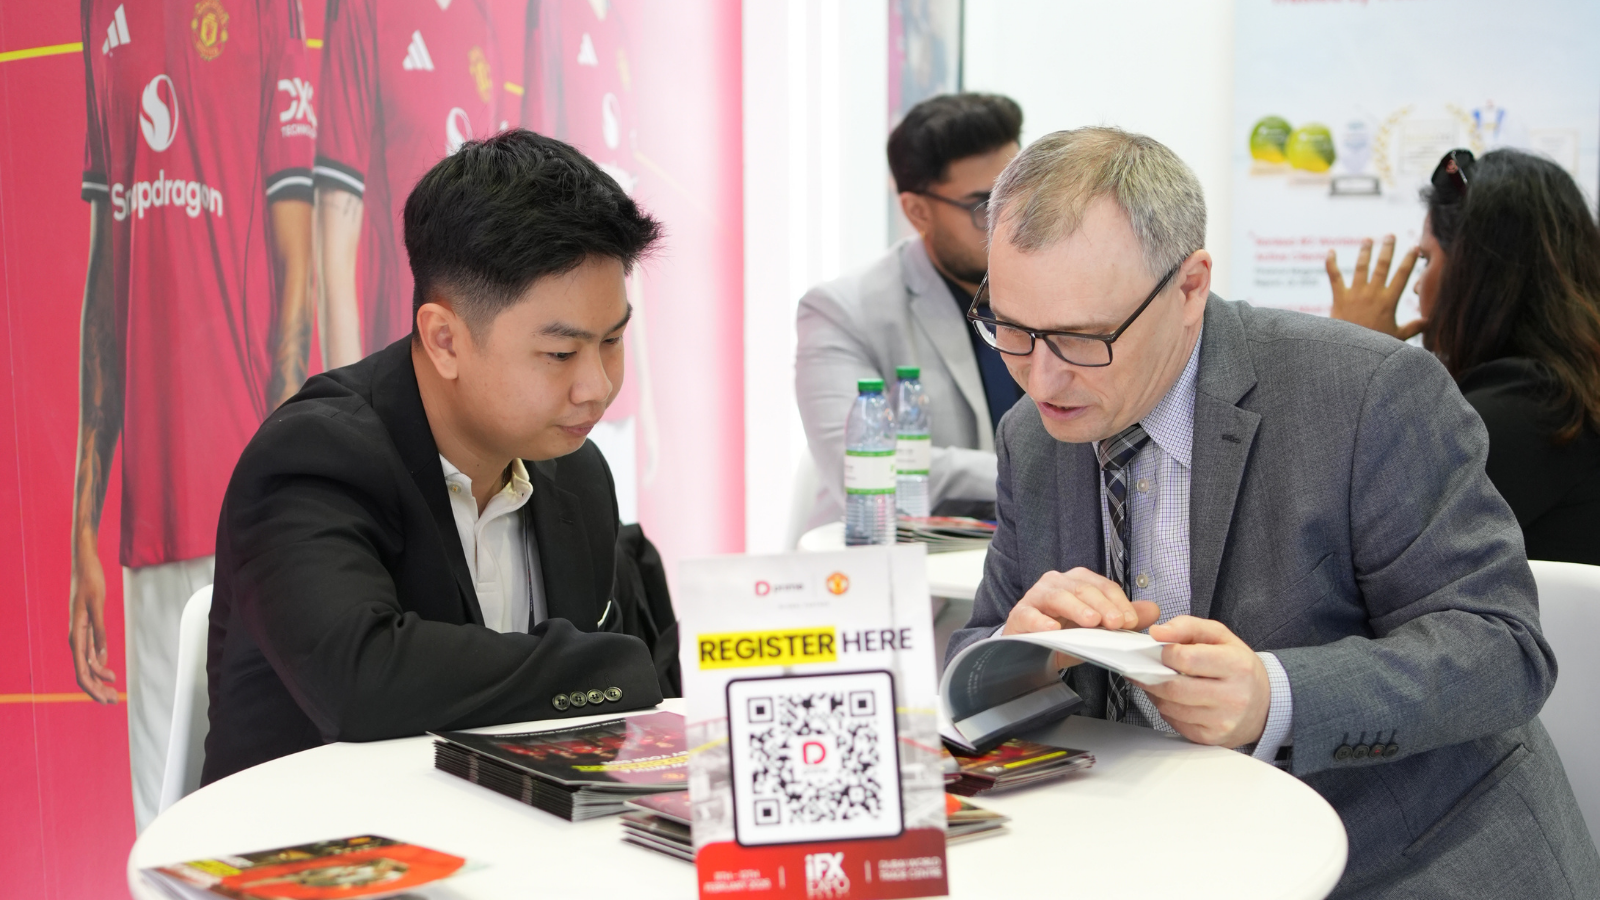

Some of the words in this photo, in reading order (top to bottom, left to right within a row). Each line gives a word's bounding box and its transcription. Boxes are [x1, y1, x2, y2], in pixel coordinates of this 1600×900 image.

[111, 169, 223, 221] Snapdragon
[700, 633, 834, 662] REGISTER
[842, 628, 912, 652] HERE
[908, 856, 942, 867] WORLD
